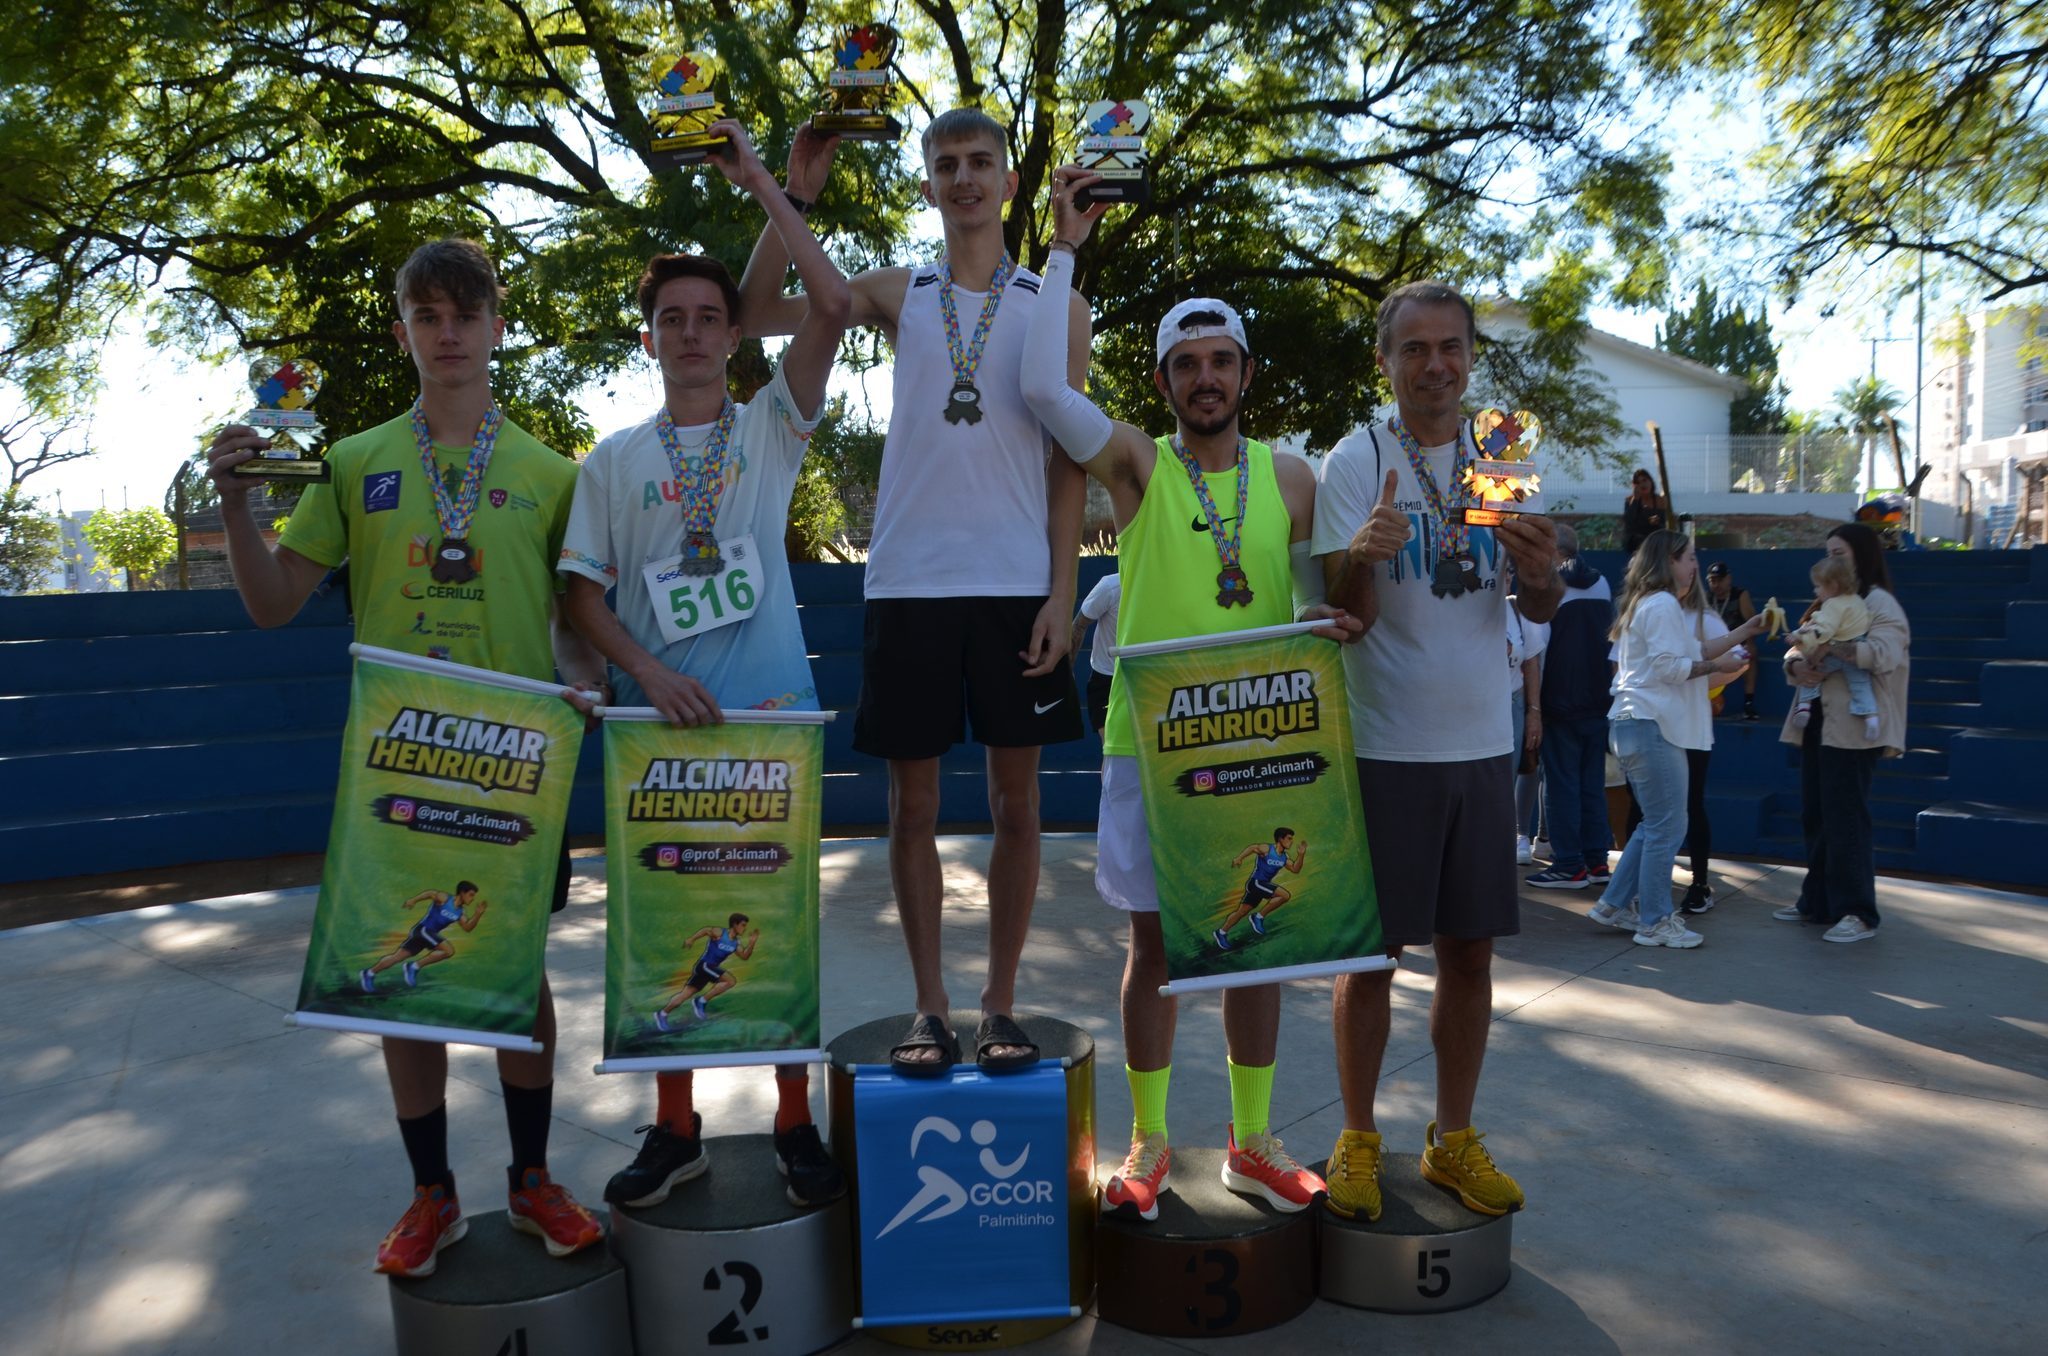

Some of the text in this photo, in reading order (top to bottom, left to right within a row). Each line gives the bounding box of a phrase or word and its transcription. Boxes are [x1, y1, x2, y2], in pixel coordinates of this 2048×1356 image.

[427, 585, 486, 602] CERILUZ
[669, 568, 755, 630] 516
[1169, 671, 1313, 719] ALCIMAR
[389, 709, 546, 762] ALCIMAR
[1162, 702, 1315, 749] HENRIQUE
[371, 739, 541, 791] HENRIQUE
[643, 759, 788, 790] ALCIMAR
[1216, 758, 1314, 784] @prof_alcimarh
[416, 803, 521, 832] @prof_alcimarh
[631, 791, 787, 821] HENRIQUE
[681, 847, 779, 863] @prof_alcimarh
[969, 1180, 1054, 1206] GCOR
[978, 1213, 1055, 1228] Palmitinho
[1417, 1248, 1451, 1298] 5
[703, 1260, 769, 1346] 2
[1185, 1249, 1241, 1330] 3
[927, 1325, 1000, 1345] Senac
